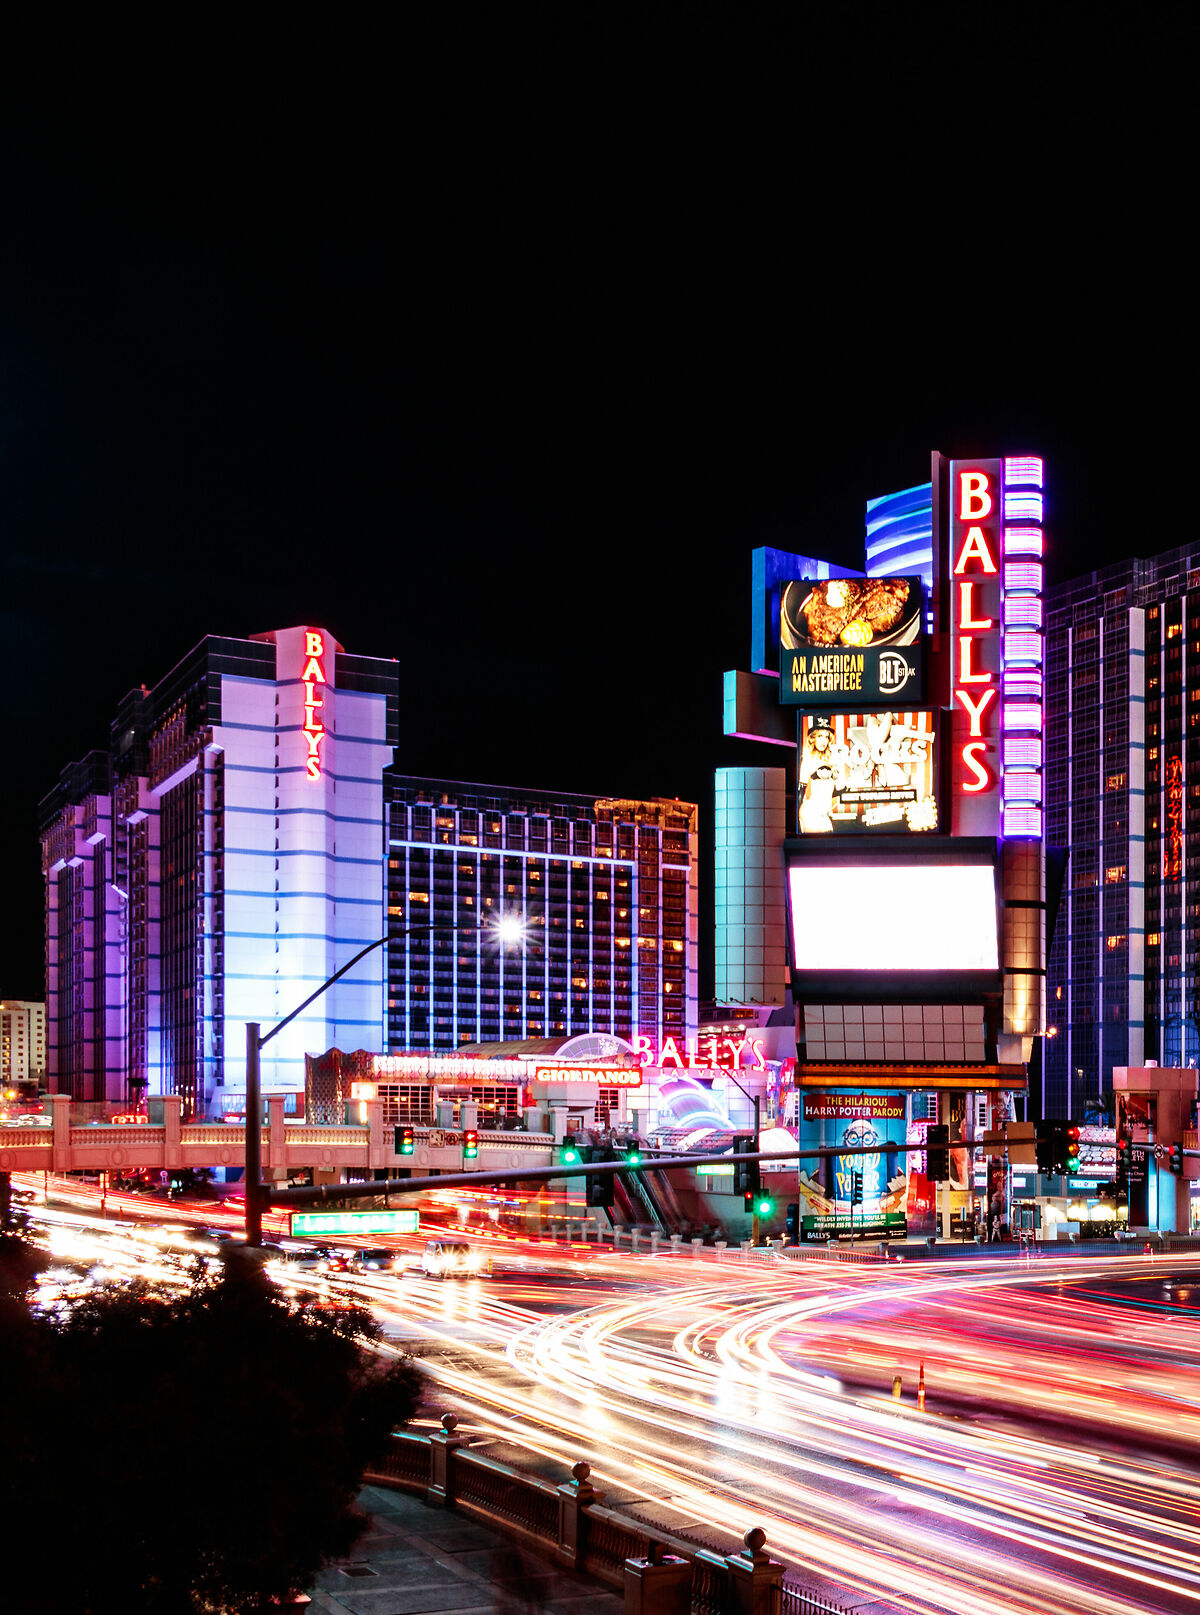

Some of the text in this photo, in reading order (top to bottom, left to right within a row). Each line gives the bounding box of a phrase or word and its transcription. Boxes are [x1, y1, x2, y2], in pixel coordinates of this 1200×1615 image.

[792, 654, 864, 674] AN AMERICAN
[879, 660, 901, 684] BLT
[898, 667, 916, 677] STAK
[792, 672, 862, 692] MASTERPIECE
[633, 1036, 766, 1071] BALLY'S
[537, 1069, 641, 1084] GIORDANO'S
[698, 1069, 746, 1079] VEGAS
[825, 1096, 887, 1107] THE HILARIOUS
[805, 1106, 903, 1117] HARRY POTTER PARODY
[836, 1172, 881, 1198] POER
[304, 1216, 335, 1231] Las
[340, 1214, 391, 1233] Vegas
